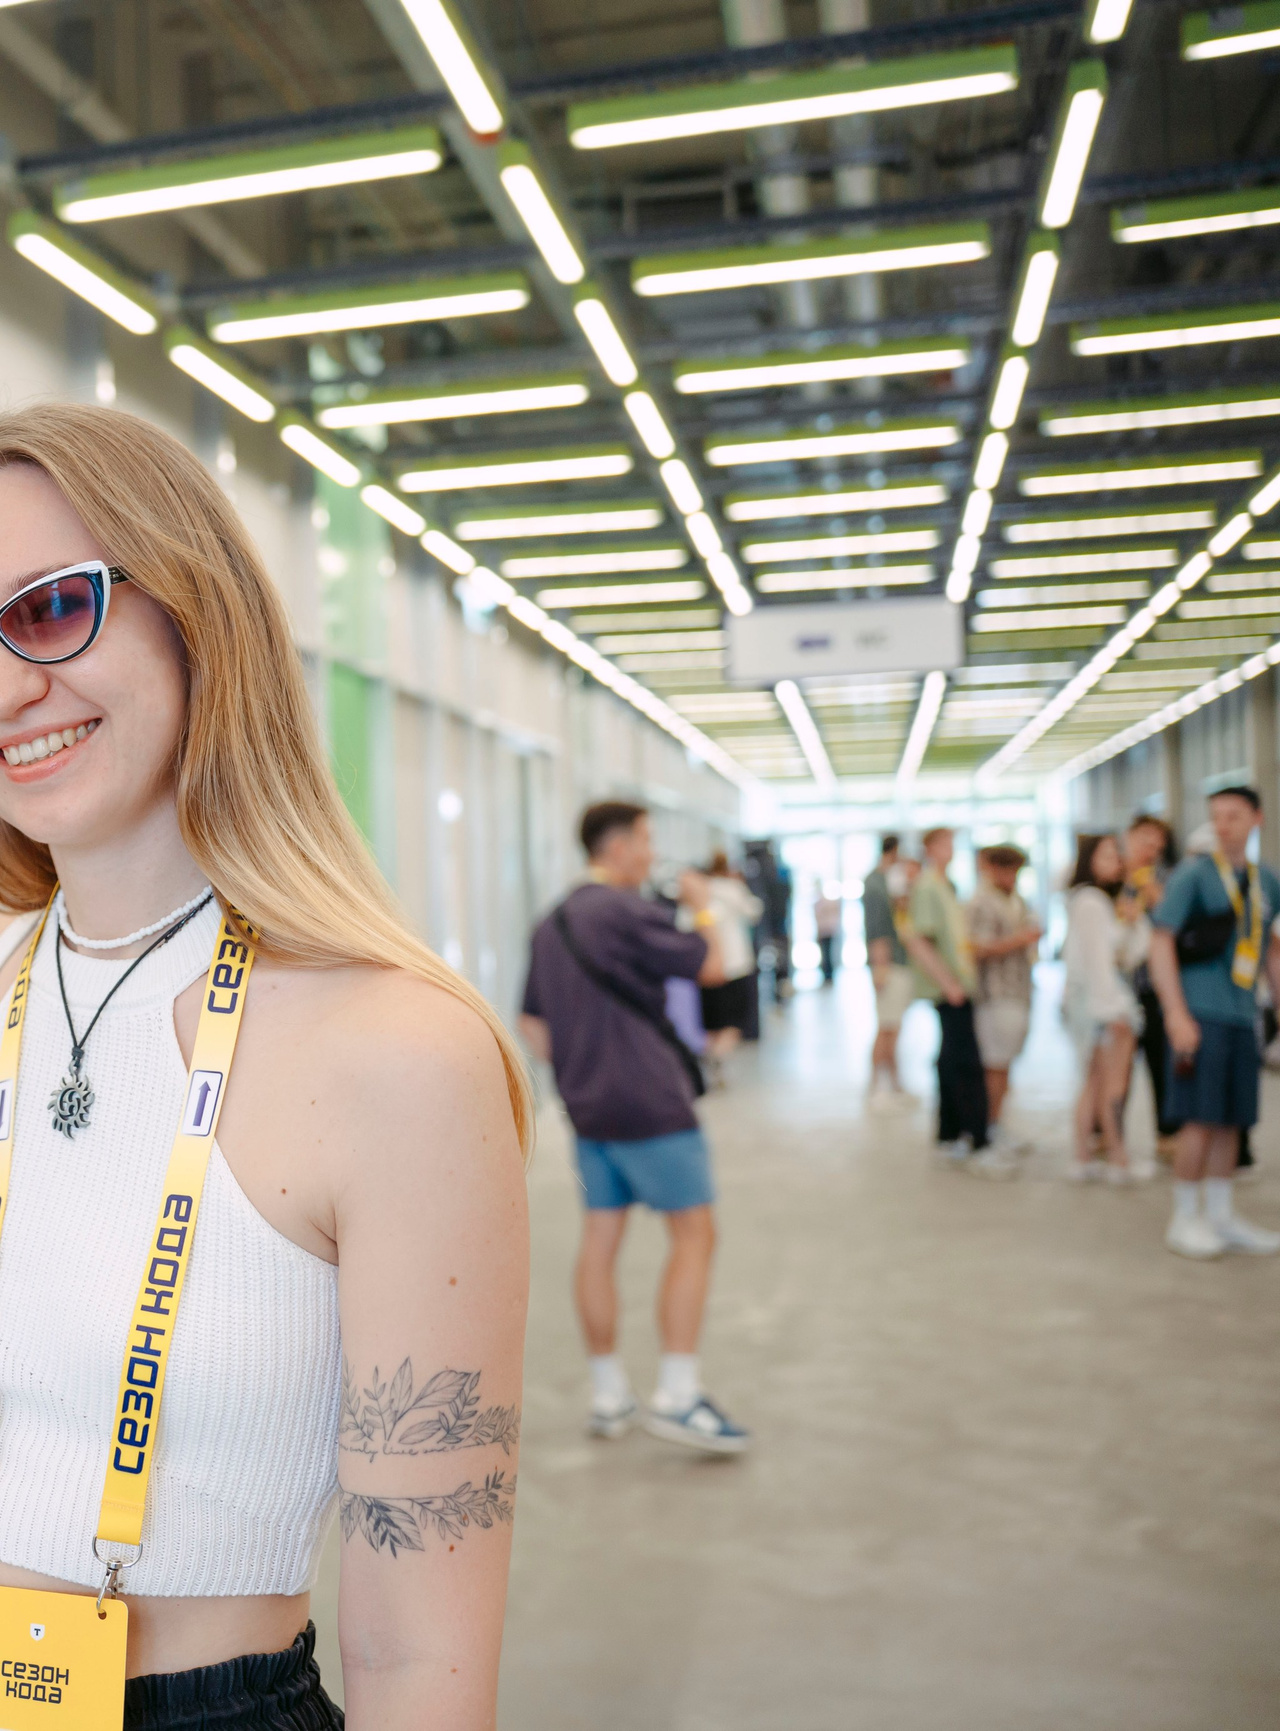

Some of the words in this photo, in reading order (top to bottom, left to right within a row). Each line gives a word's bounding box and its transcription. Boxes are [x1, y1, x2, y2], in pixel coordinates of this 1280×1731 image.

[113, 1324, 166, 1475] сезон
[140, 1194, 193, 1316] кода
[1, 1660, 70, 1686] сезон
[6, 1680, 62, 1704] кода
